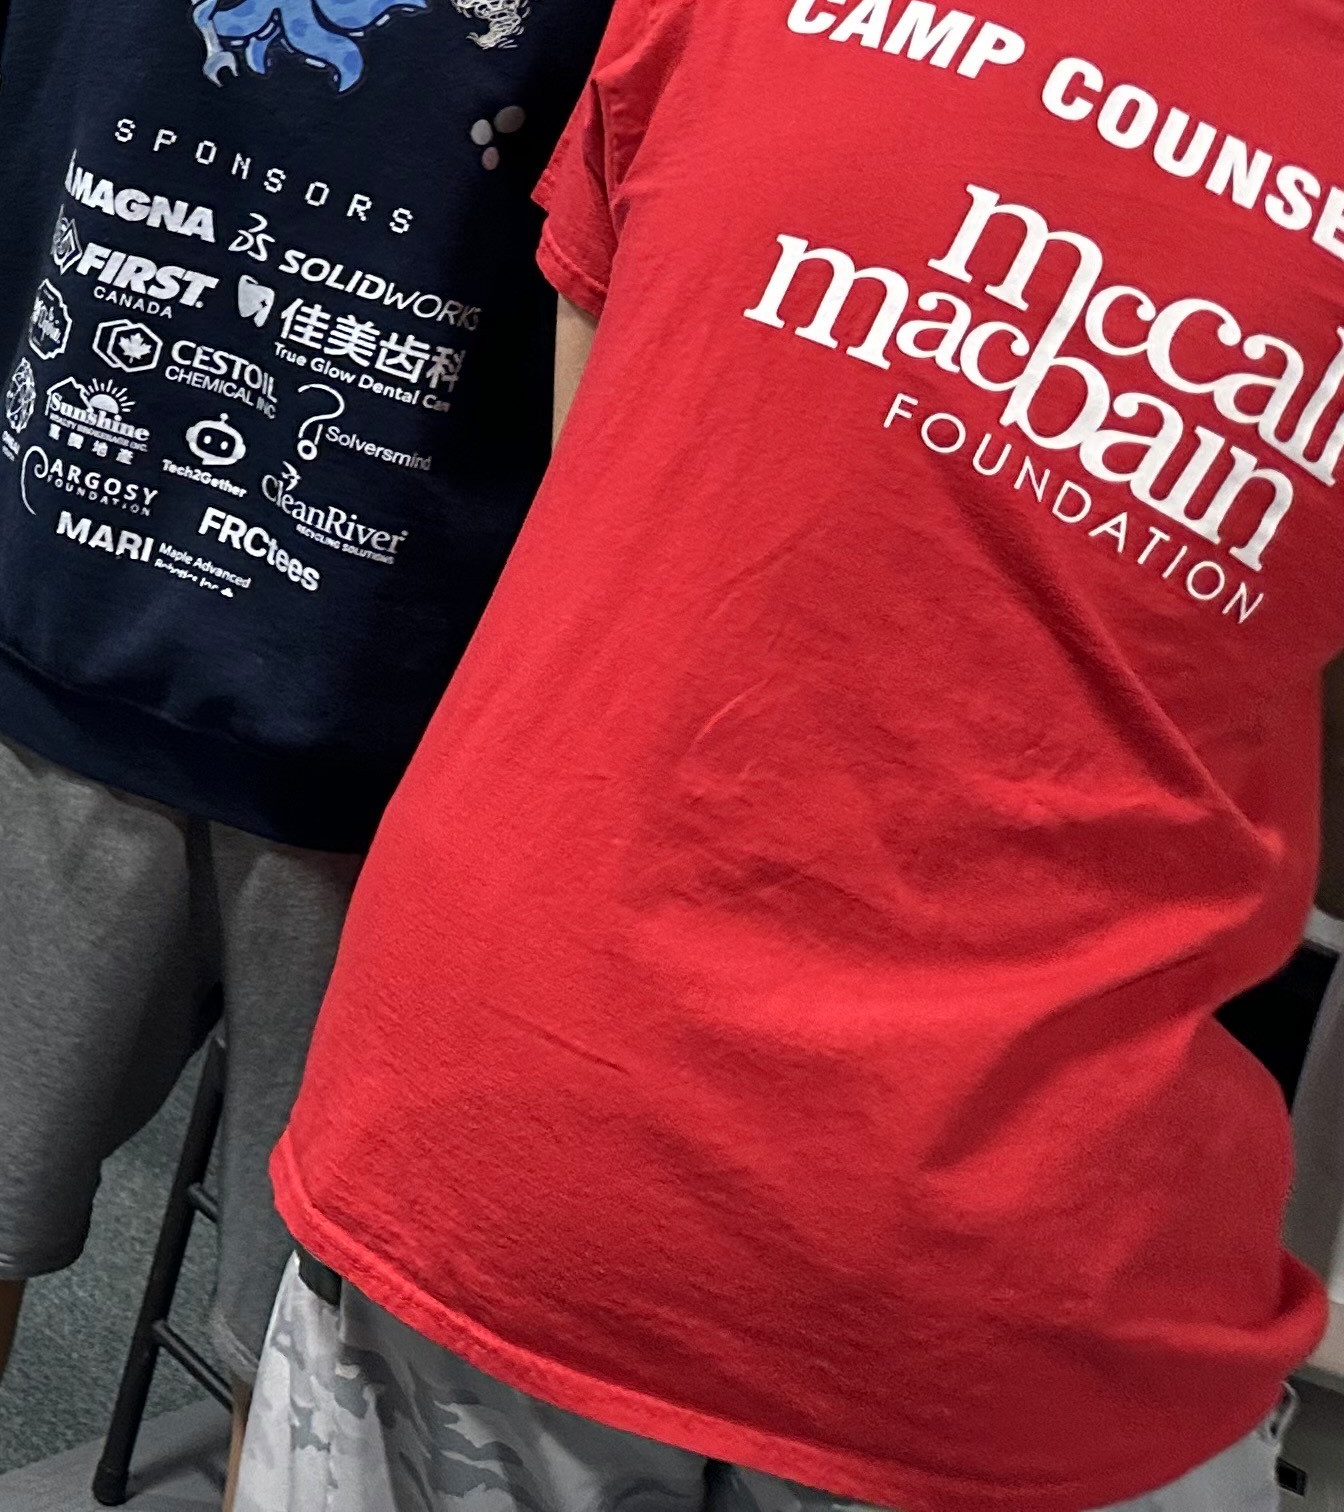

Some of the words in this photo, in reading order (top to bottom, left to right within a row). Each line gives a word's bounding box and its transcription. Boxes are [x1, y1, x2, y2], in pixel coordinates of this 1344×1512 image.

[114, 117, 414, 234] SPONSORS
[1041, 56, 1344, 266] COUNSE
[64, 148, 216, 243] MAGNA
[278, 249, 482, 331] SOLIDWORKS
[93, 285, 173, 319] CANADA
[280, 298, 467, 393] 佳美齿科
[928, 184, 1344, 487] mccal
[165, 365, 254, 406] CHEMICAL
[171, 340, 278, 404] CESTOIL
[274, 342, 307, 367] True
[310, 357, 356, 384] Glow
[358, 374, 420, 405] Dental
[743, 233, 1295, 572] macbain
[50, 392, 150, 441] Sunshine
[325, 425, 433, 471] Solversmind
[47, 475, 151, 517] FOUNDATION
[50, 458, 159, 506] ARGOSY
[162, 458, 247, 498] Tech2Gether
[883, 391, 1265, 625] FOUNDATION
[262, 474, 408, 554] CleanRiver
[56, 510, 154, 562] MARI
[197, 506, 320, 592] FRCtees
[158, 542, 194, 565] Maple
[192, 557, 252, 589] Advanced
